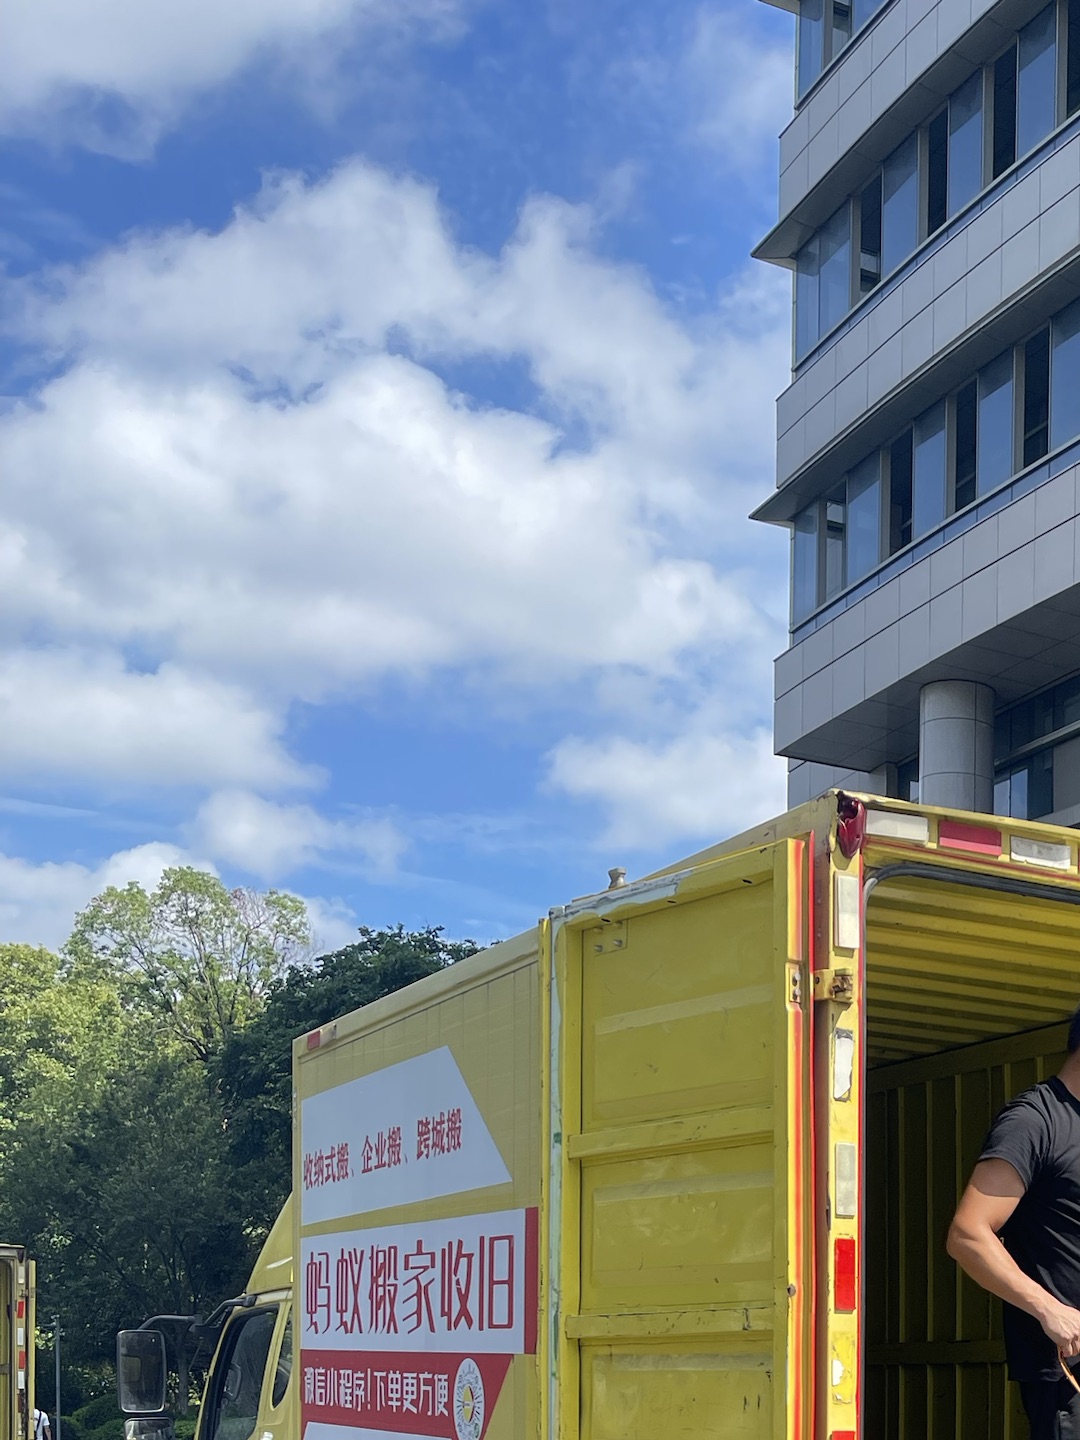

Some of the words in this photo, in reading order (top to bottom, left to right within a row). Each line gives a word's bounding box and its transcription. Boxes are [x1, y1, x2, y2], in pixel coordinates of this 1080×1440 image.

[306, 1234, 515, 1334] 蚂蚁搬家收旧
